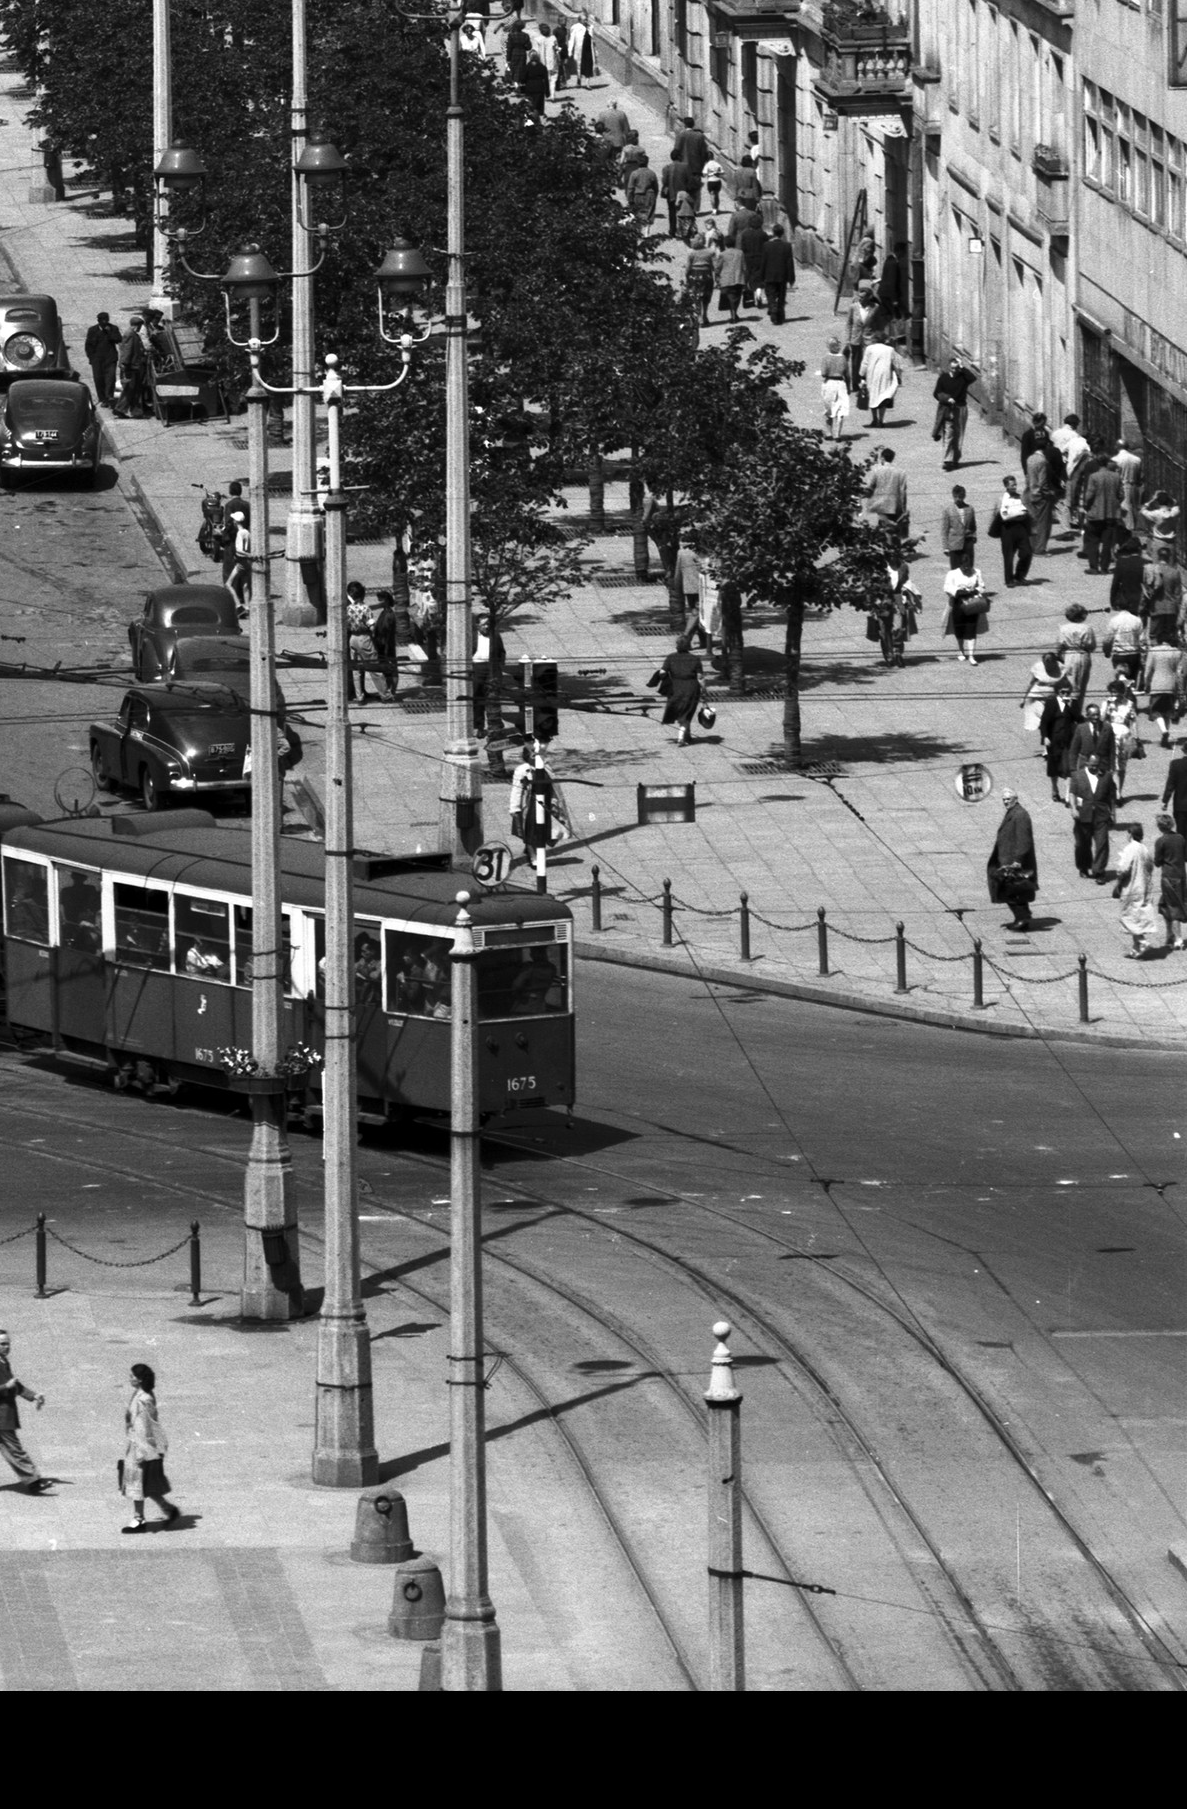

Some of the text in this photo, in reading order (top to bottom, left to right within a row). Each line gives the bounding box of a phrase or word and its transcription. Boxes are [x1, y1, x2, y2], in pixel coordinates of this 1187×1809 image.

[475, 847, 507, 882] 31
[194, 1047, 214, 1063] 1675
[506, 1075, 537, 1092] 1675
